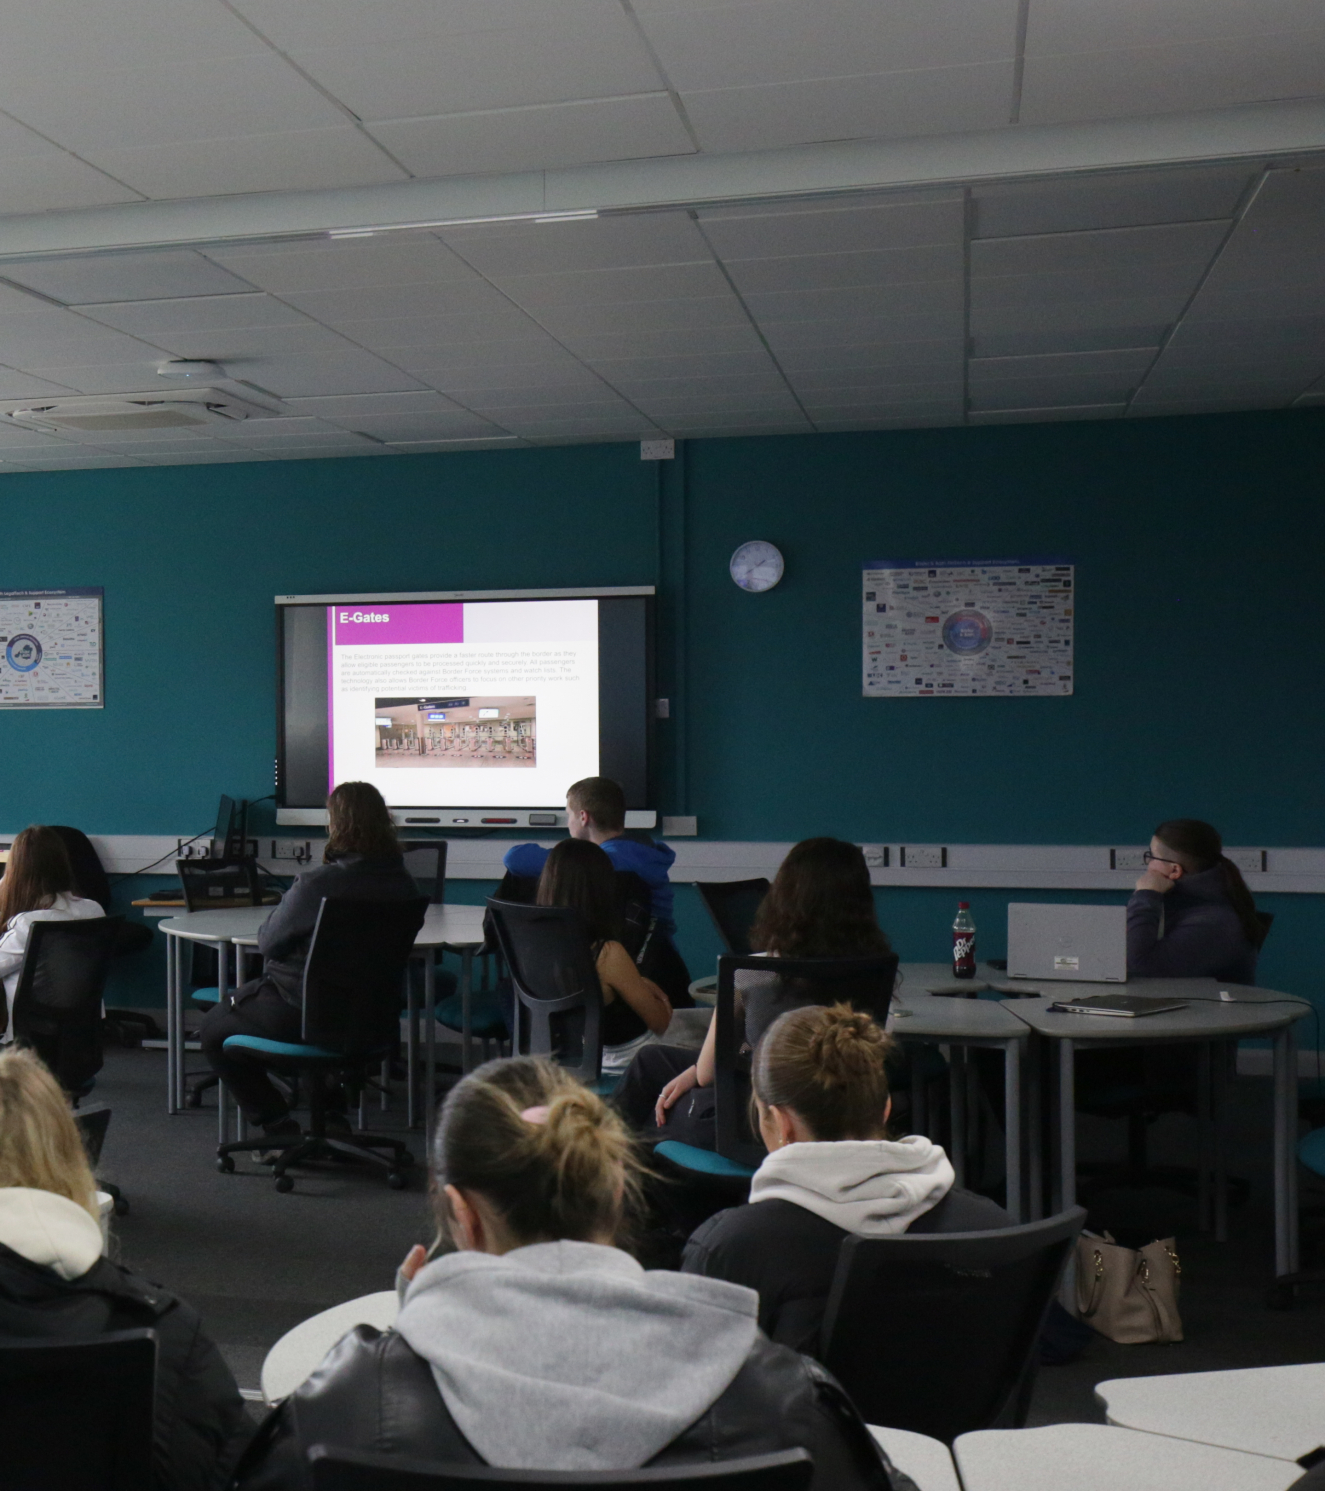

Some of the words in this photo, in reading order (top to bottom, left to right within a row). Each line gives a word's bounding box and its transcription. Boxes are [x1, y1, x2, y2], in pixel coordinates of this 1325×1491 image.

[339, 611, 390, 623] E-Gates
[385, 653, 411, 661] passport
[956, 938, 967, 950] Dr
